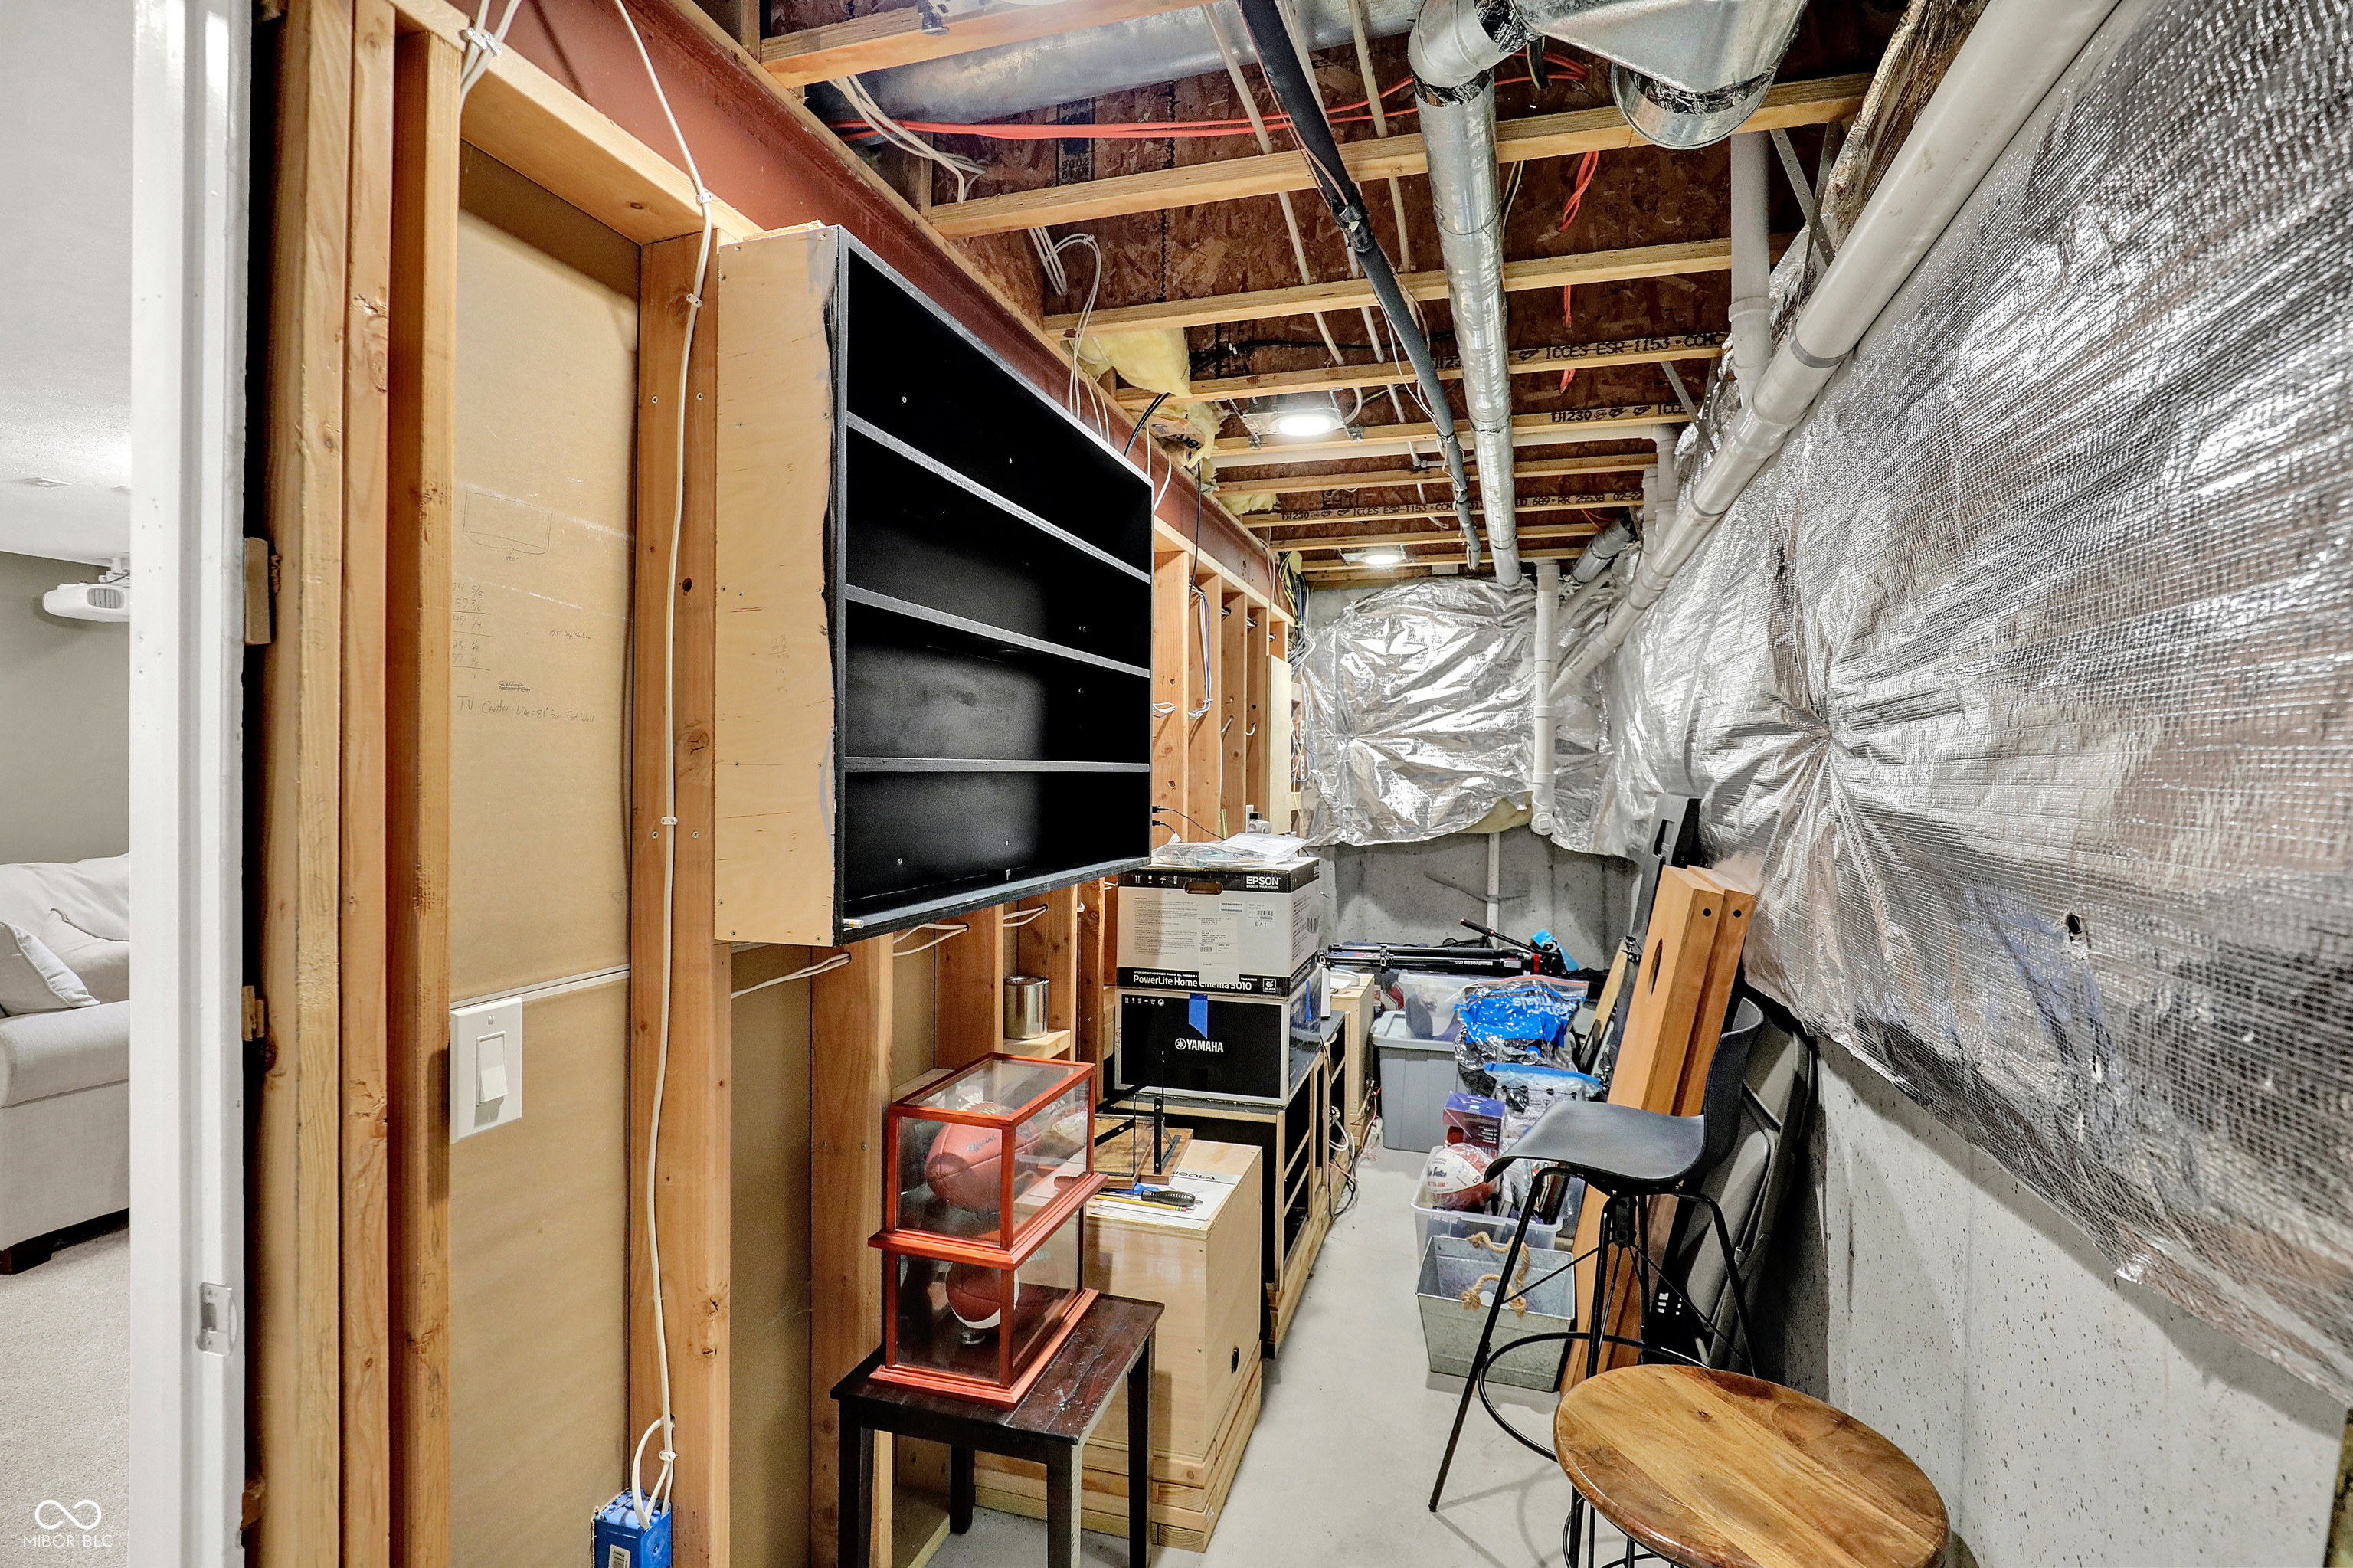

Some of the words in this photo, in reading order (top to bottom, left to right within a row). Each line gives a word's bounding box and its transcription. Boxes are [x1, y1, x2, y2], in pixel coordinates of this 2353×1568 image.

[457, 696, 474, 710] TV
[1246, 876, 1279, 885] EPSON
[1134, 974, 1173, 986] PowerLite
[1174, 977, 1198, 987] Home
[1230, 981, 1252, 990] 3010
[1186, 1039, 1224, 1053] YAMAHA
